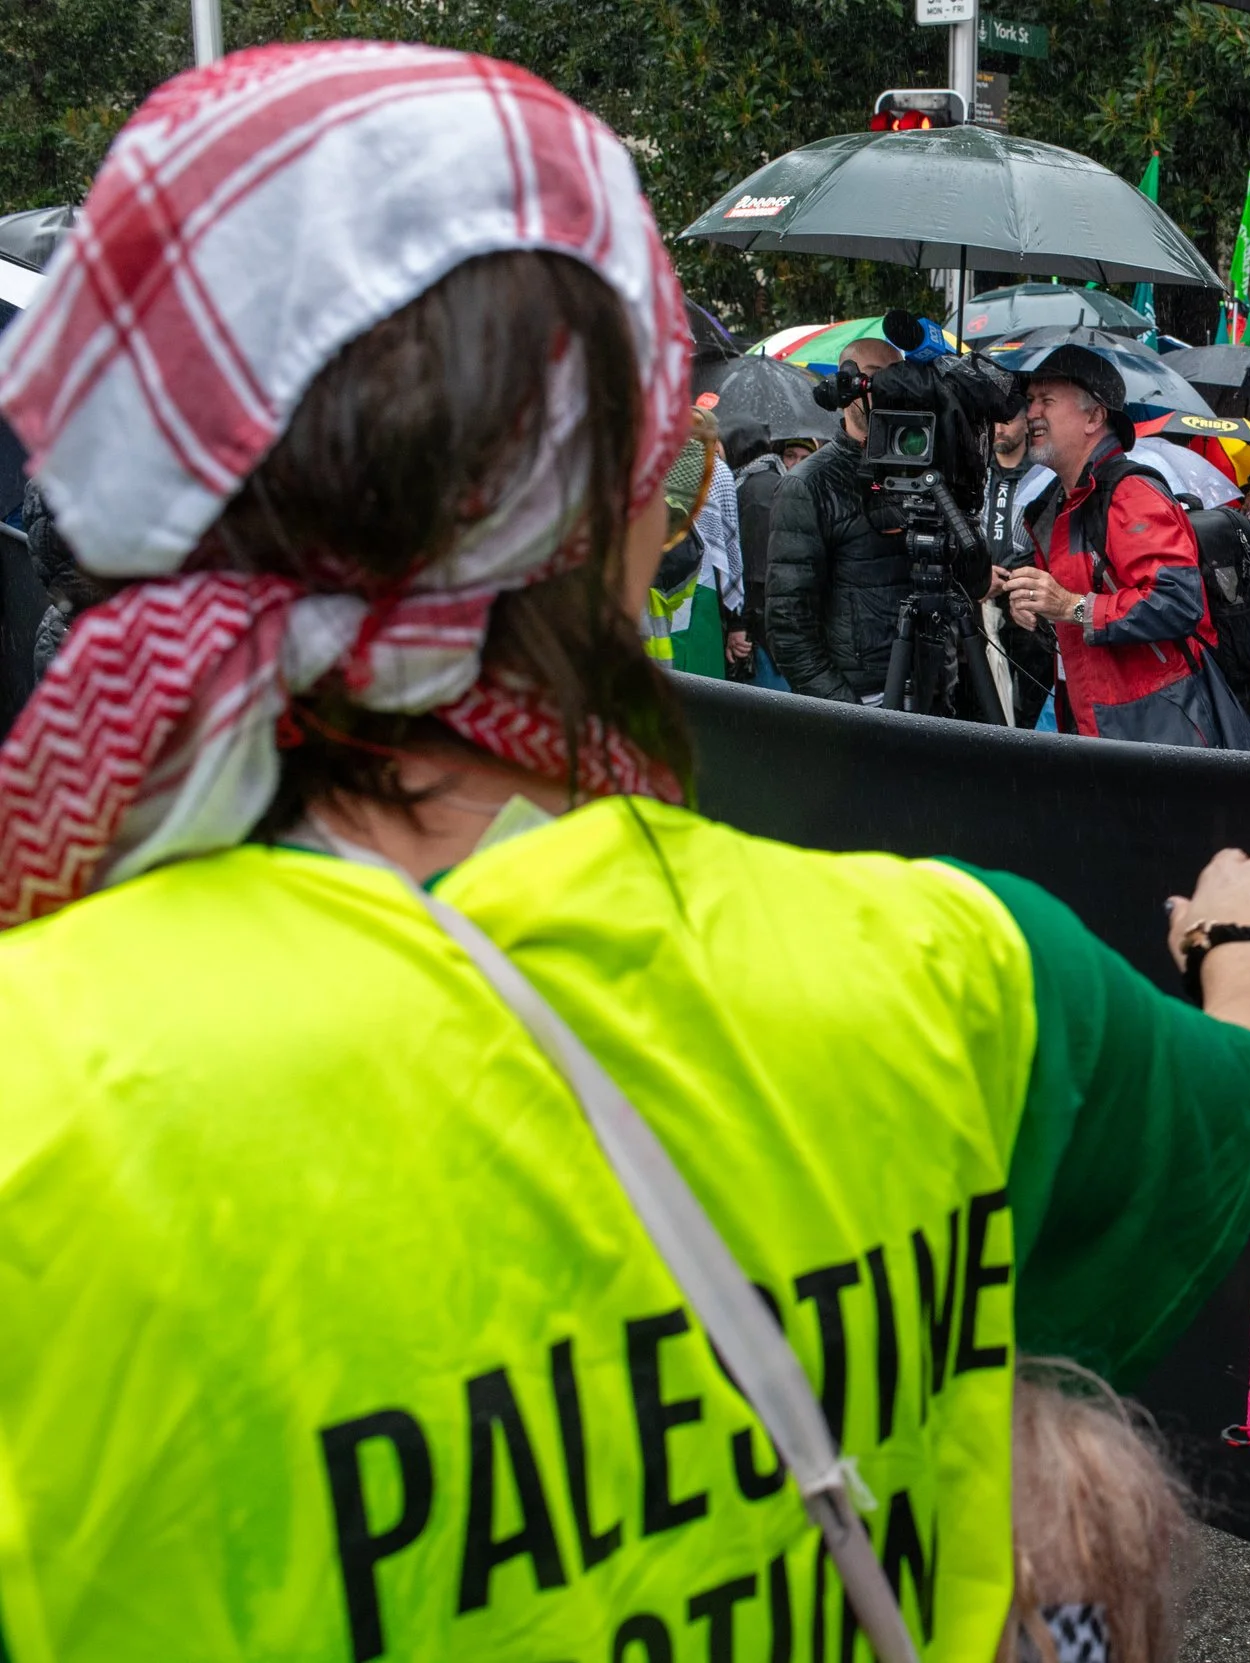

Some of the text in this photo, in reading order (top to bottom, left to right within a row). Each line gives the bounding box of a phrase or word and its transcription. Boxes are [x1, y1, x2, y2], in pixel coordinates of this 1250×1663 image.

[927, 7, 943, 15] MON
[993, 21, 1029, 44] York St
[994, 513, 1004, 540] AIR
